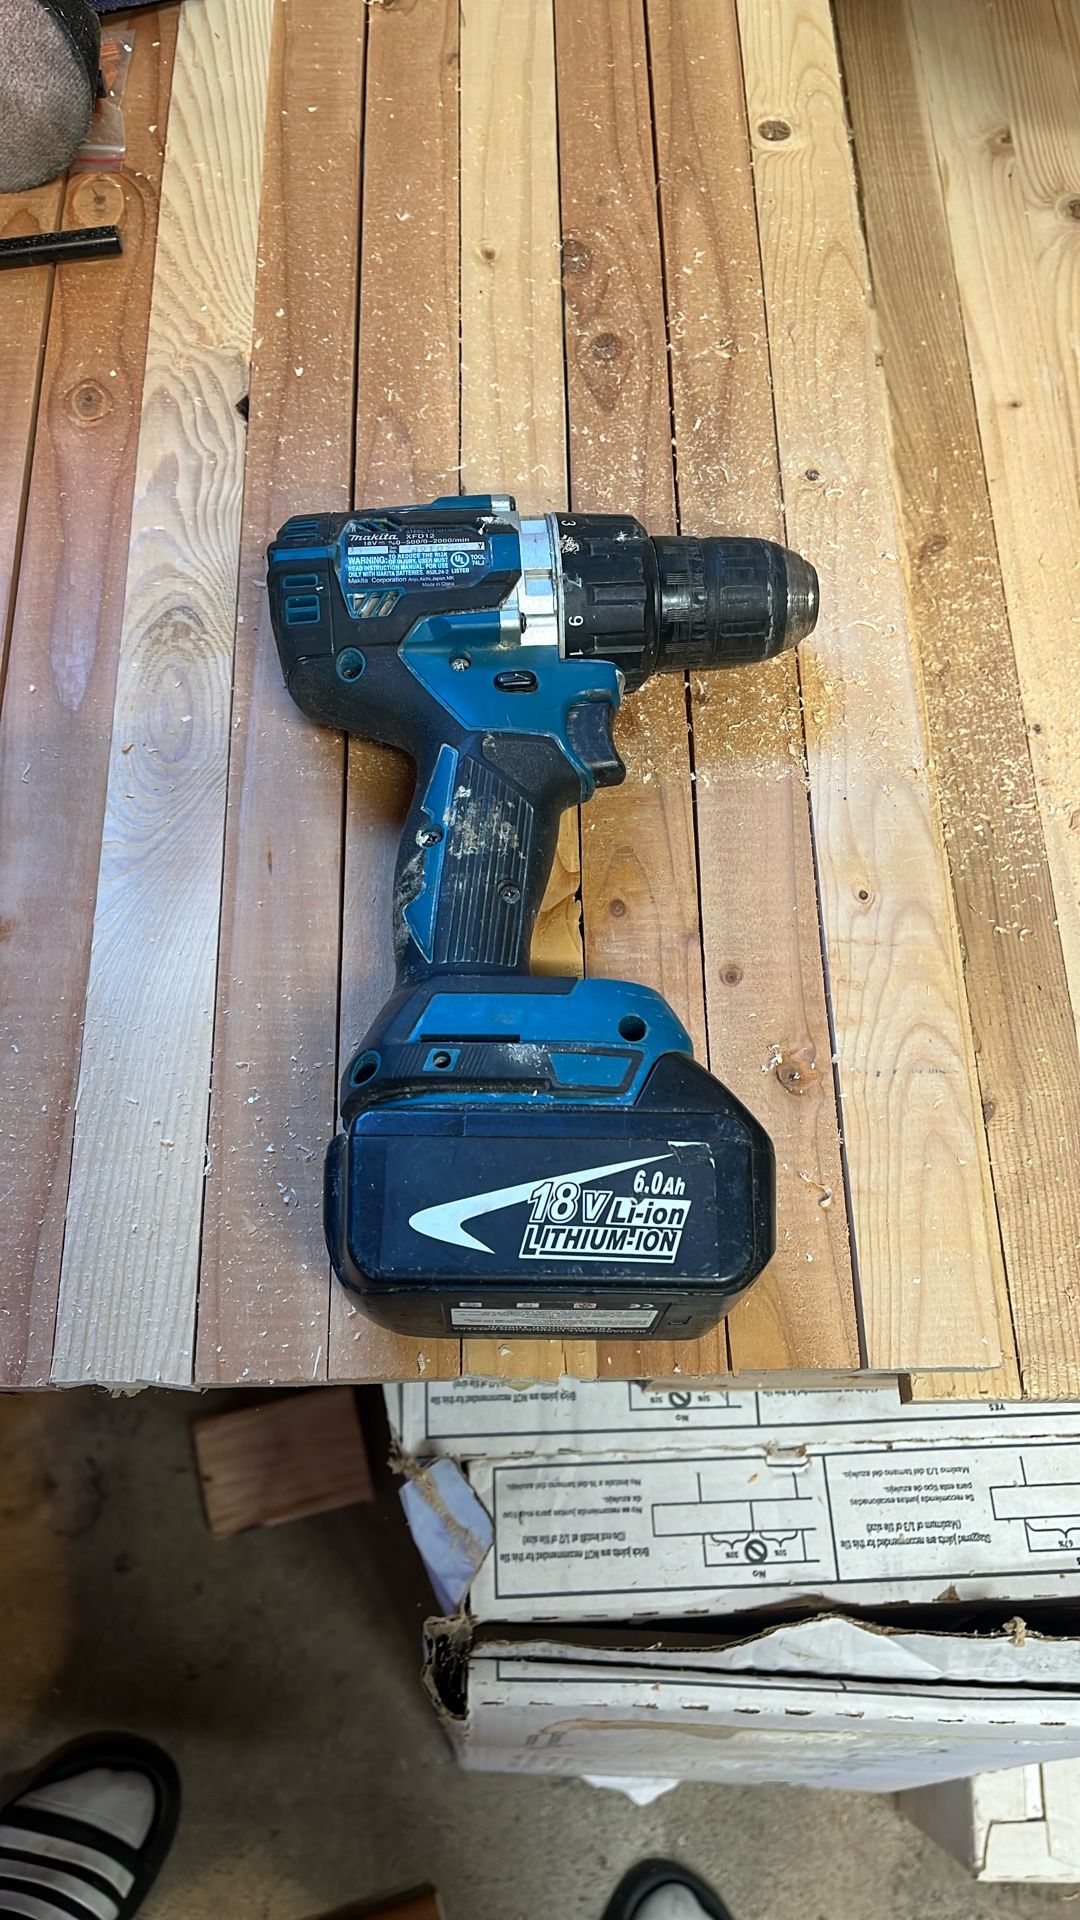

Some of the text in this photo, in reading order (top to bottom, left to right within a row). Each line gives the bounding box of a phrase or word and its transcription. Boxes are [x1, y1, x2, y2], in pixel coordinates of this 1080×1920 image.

[349, 533, 399, 541] makita
[348, 556, 388, 565] WARNING:
[633, 1169, 687, 1196] 6.0Ah
[610, 1199, 685, 1225] Li-ion
[521, 1227, 678, 1256] LITHIUM-ION
[513, 1394, 528, 1403] NOT
[989, 1403, 1006, 1412] YES
[584, 1550, 599, 1560] NOT
